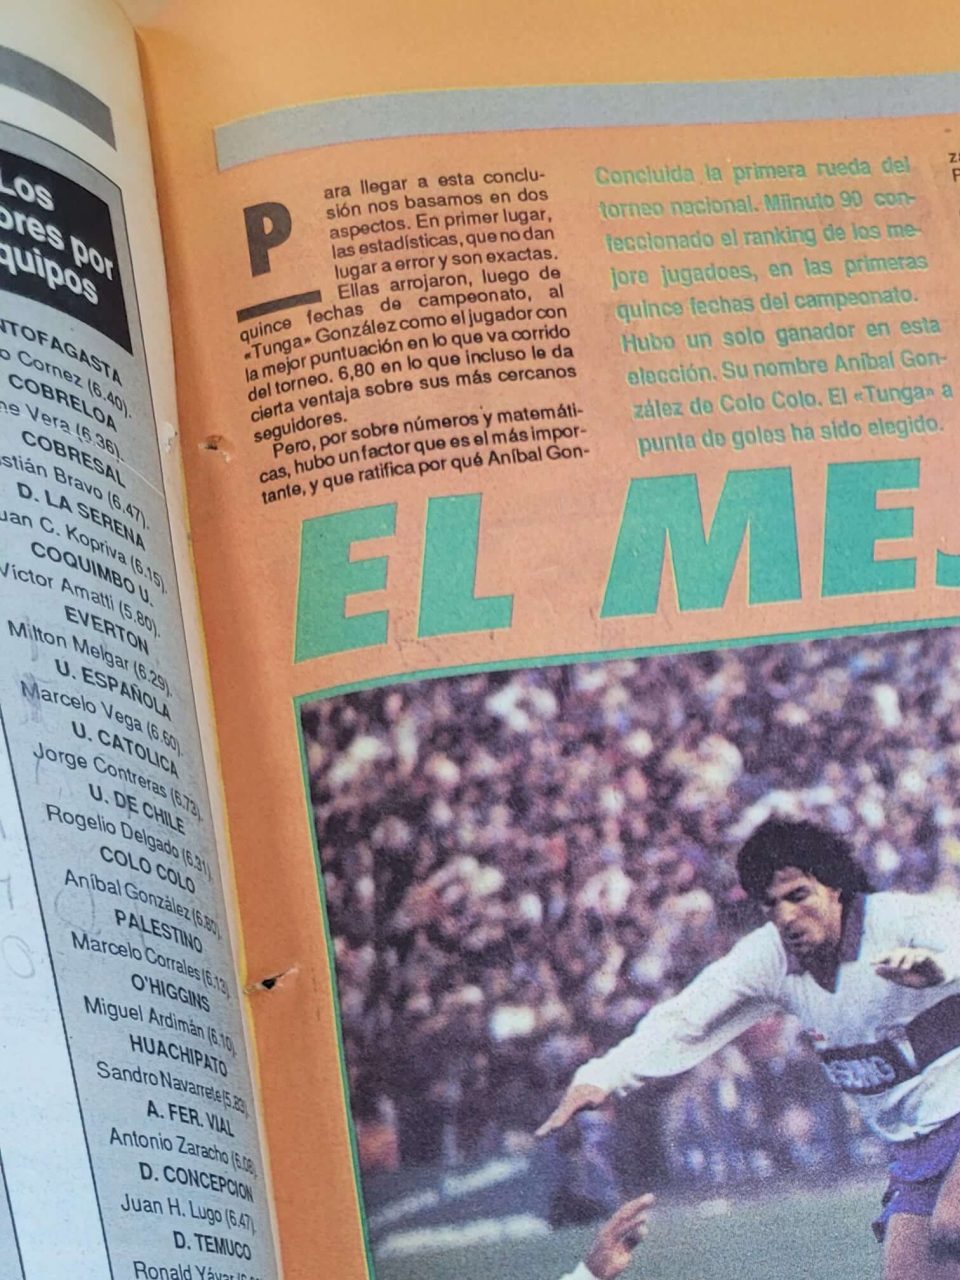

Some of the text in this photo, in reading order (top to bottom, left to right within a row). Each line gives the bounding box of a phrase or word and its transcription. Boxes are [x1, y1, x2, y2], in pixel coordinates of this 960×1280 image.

[324, 168, 546, 200] ara llegar a esta conclu-
[243, 202, 292, 277] P
[330, 208, 552, 242] aspectos. En primer lugar,
[70, 235, 113, 280] por
[615, 300, 683, 325] quince
[760, 292, 788, 311] del
[794, 287, 918, 311] campeonato.
[621, 318, 941, 353] Hubo un solo ganador en esta
[9, 374, 117, 432] COBRELOA
[251, 367, 576, 423] cierta ventaja sobre sus más cercanos
[22, 430, 126, 488] COBRESAL
[18, 482, 145, 551] D. LA SERENA
[31, 542, 154, 606] COQUIMBO U.
[293, 493, 514, 664] EL
[8, 620, 67, 649] Milton
[73, 636, 129, 672] Melgar
[65, 606, 149, 655] EVERTON
[55, 659, 171, 721] U. ESPAÑOLA
[72, 721, 179, 778] U. CATOLICA
[100, 846, 196, 894] COLO COLO
[132, 973, 210, 1012] O'HIGGINS
[130, 1034, 228, 1077] HUACHIPATO
[147, 1100, 234, 1138] A. FER. VIAL
[139, 1162, 254, 1202] D. CONCEPCION
[173, 1230, 252, 1260] D. TEMUCO
